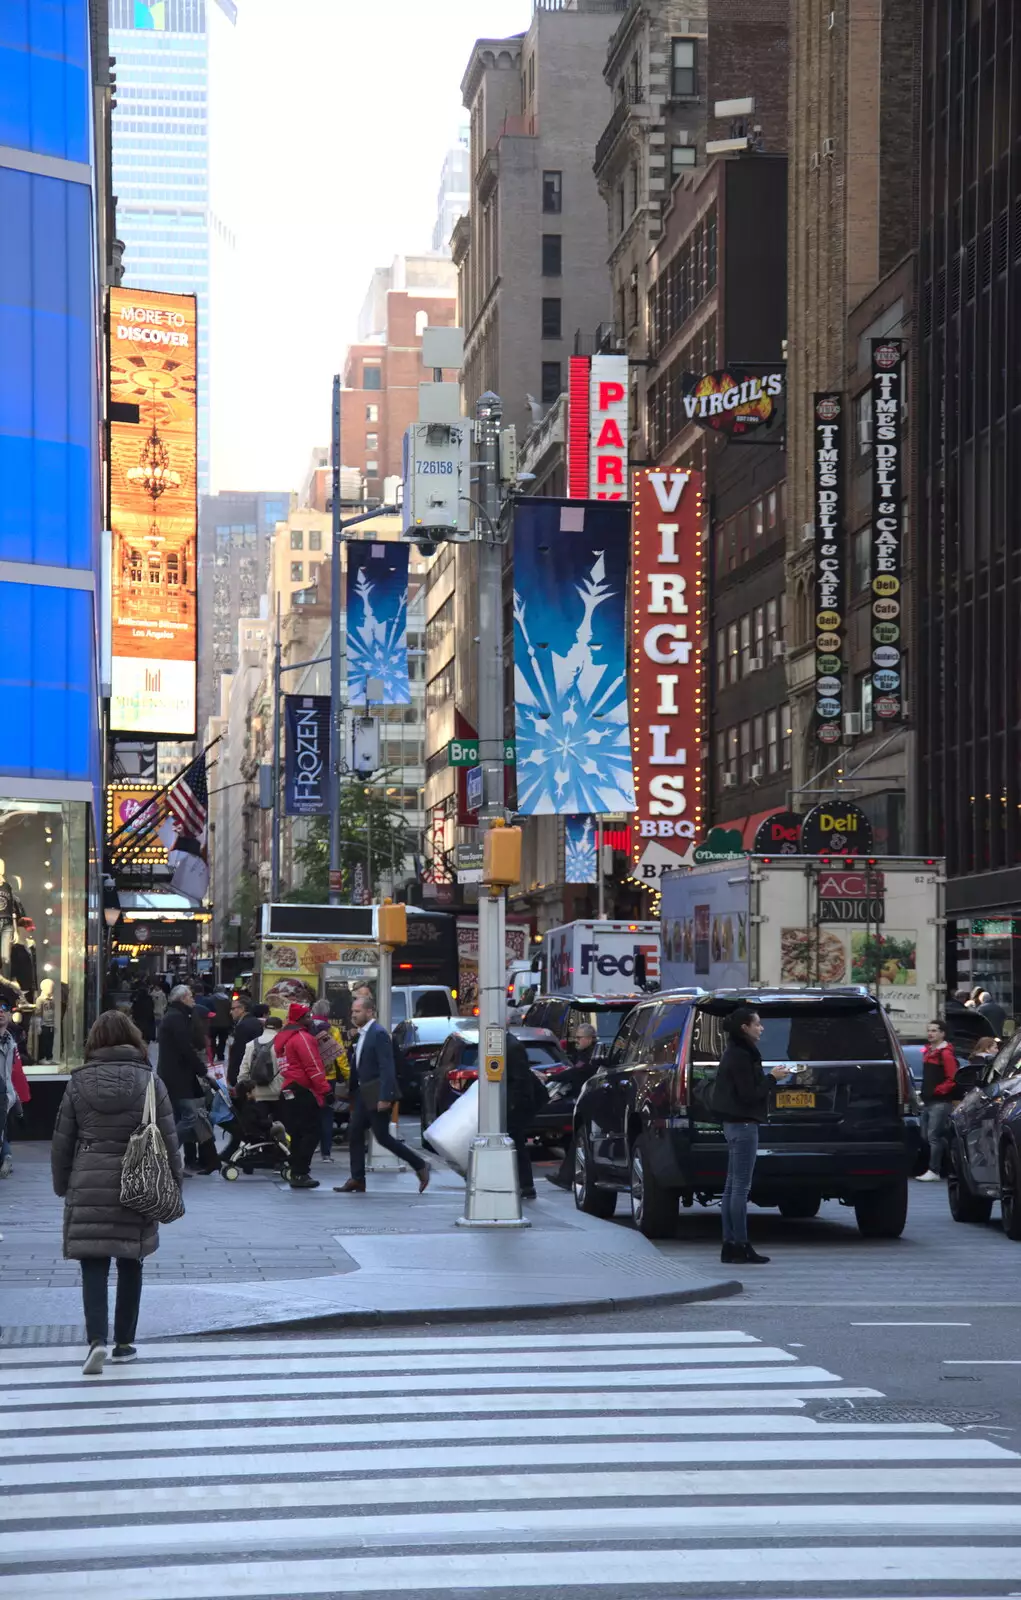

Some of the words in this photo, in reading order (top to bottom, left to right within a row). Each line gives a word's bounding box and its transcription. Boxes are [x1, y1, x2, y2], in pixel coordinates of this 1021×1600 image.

[120, 307, 163, 325] MORE
[165, 312, 184, 326] TO
[117, 325, 188, 347] DISCOVER
[683, 373, 782, 418] VIRGIL'S
[874, 373, 897, 440] TIMES
[817, 425, 839, 487] TIMES
[416, 461, 453, 475] 726158
[875, 445, 897, 497] DELI
[818, 490, 838, 540] DELI
[878, 502, 895, 514] &
[820, 545, 837, 555] &
[874, 518, 899, 571] CAFE
[817, 558, 840, 608] CAFE
[876, 581, 896, 590] Deli
[875, 604, 897, 613] Cafe
[818, 616, 838, 625] Deli
[132, 629, 145, 637] Los
[145, 630, 174, 640] Angeles
[643, 472, 693, 816] VIRGILS
[818, 637, 839, 647] Cafe
[294, 709, 323, 800] FROZEN
[640, 820, 695, 838] BBQ
[820, 814, 857, 832] Deli
[819, 900, 883, 919] ENDICO
